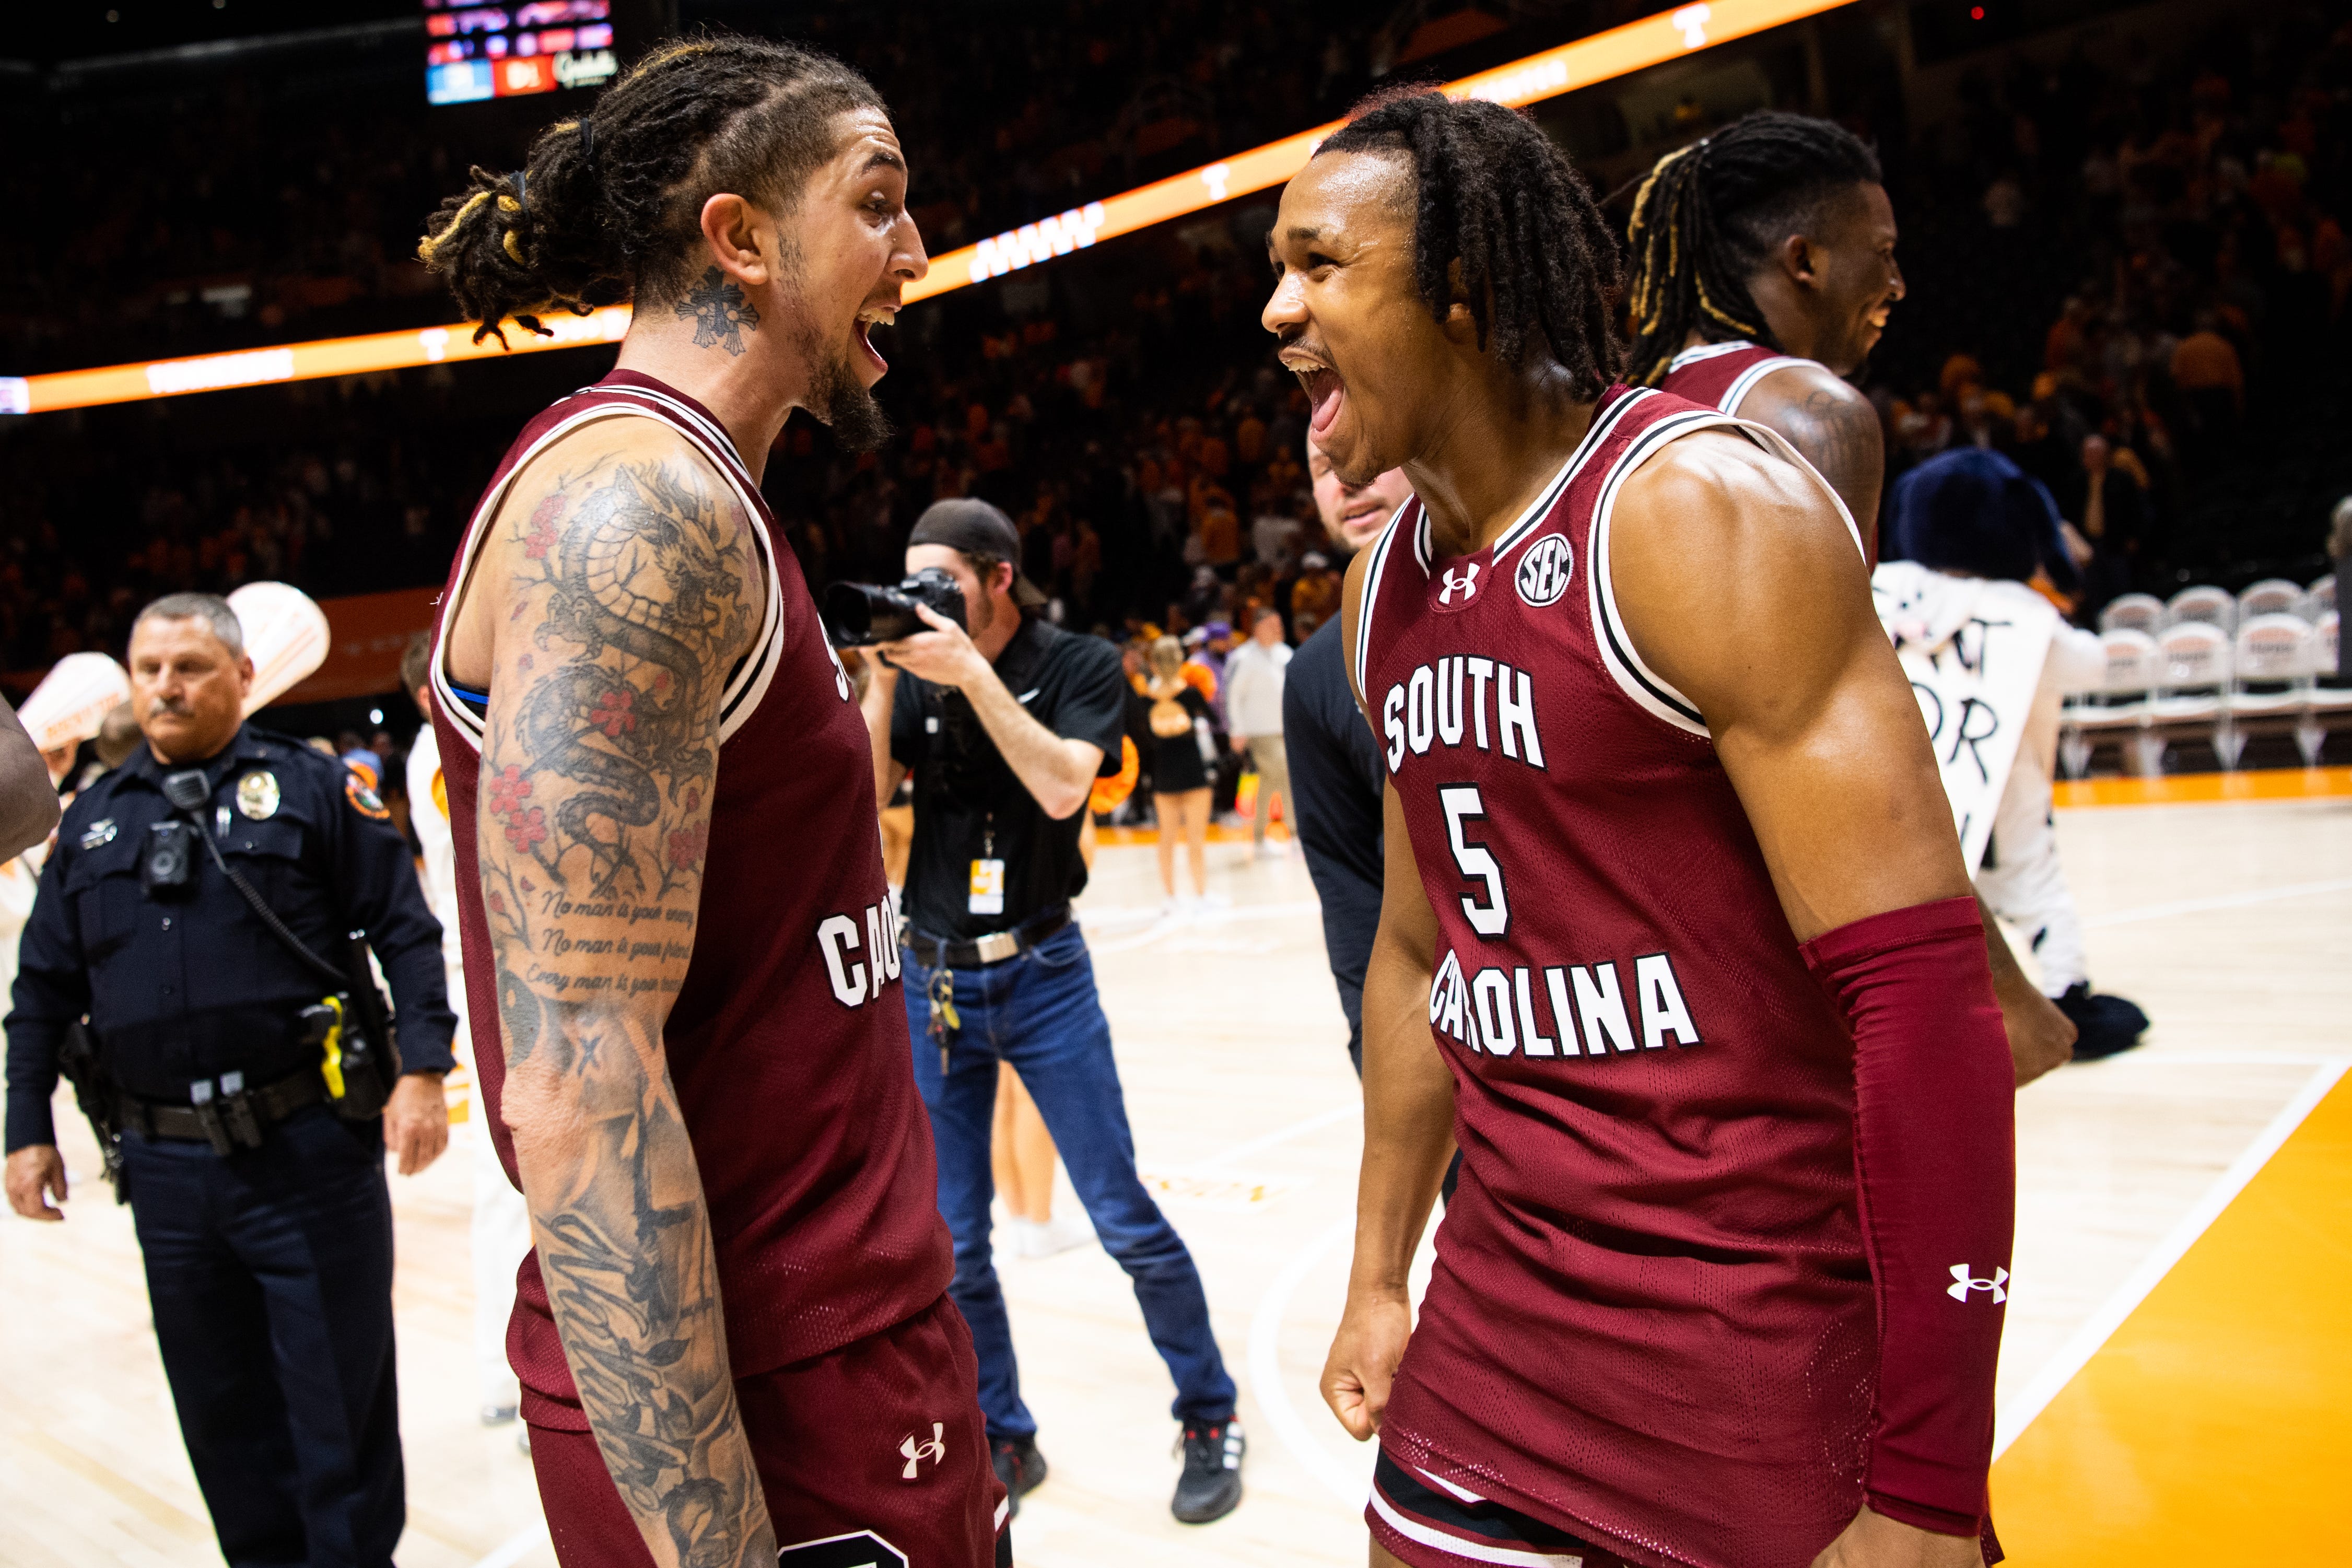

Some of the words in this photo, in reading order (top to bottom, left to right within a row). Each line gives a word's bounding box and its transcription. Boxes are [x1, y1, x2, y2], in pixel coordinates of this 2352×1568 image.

[1519, 538, 1569, 601] SEC
[1383, 654, 1548, 775] SOUTH
[1437, 783, 1512, 939] 5
[541, 890, 572, 919] No
[574, 903, 614, 917] man
[543, 928, 571, 957] No
[575, 939, 613, 954] man
